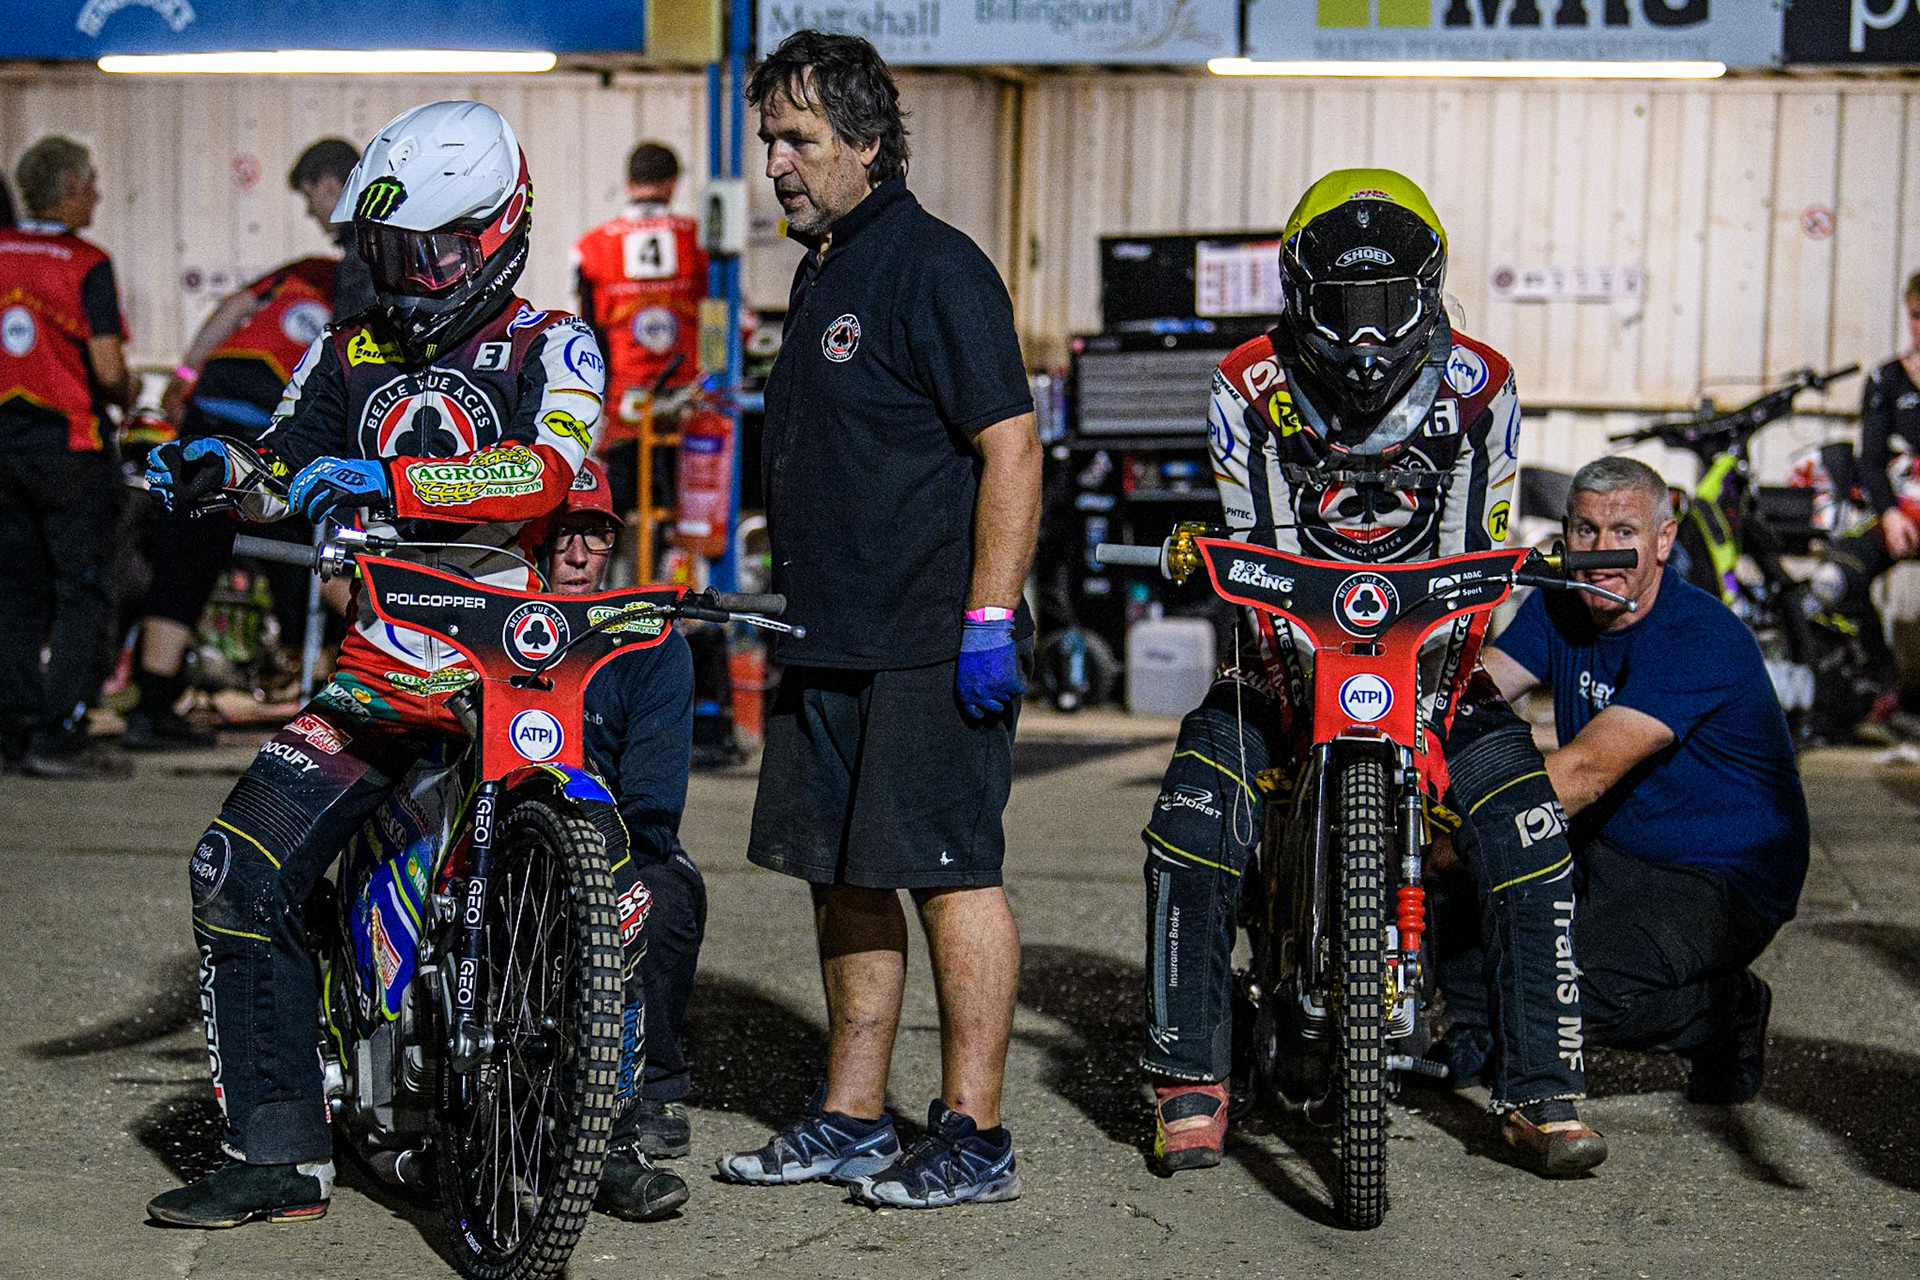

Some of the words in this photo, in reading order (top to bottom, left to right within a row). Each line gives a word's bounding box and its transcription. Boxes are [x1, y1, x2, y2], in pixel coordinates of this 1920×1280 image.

[639, 237, 661, 267] 4
[1343, 248, 1387, 265] SHOEI
[484, 344, 508, 370] 3
[367, 383, 409, 430] BELLE
[416, 374, 451, 392] VUE
[453, 386, 491, 429] ACES
[417, 462, 535, 482] AGROMIX
[1227, 567, 1294, 593] RACING
[1338, 579, 1359, 599] BELLE
[1361, 576, 1378, 584] VUE
[1379, 582, 1395, 600] ACES
[1462, 570, 1483, 580] ADAC
[386, 592, 486, 609] POLCOPPER
[1462, 586, 1483, 597] Sport
[509, 605, 530, 629] BELLE
[532, 606, 549, 615] VUE
[550, 608, 566, 633] ACES
[1348, 690, 1382, 705] ATPI
[583, 711, 604, 726] Rab
[519, 726, 553, 743] ATPI
[474, 799, 492, 843] GEO
[466, 879, 483, 924] GEO
[1168, 905, 1181, 940] Broker
[1168, 940, 1179, 988] Insurance
[457, 959, 475, 1005] GEO
[1557, 1016, 1585, 1074] MF
